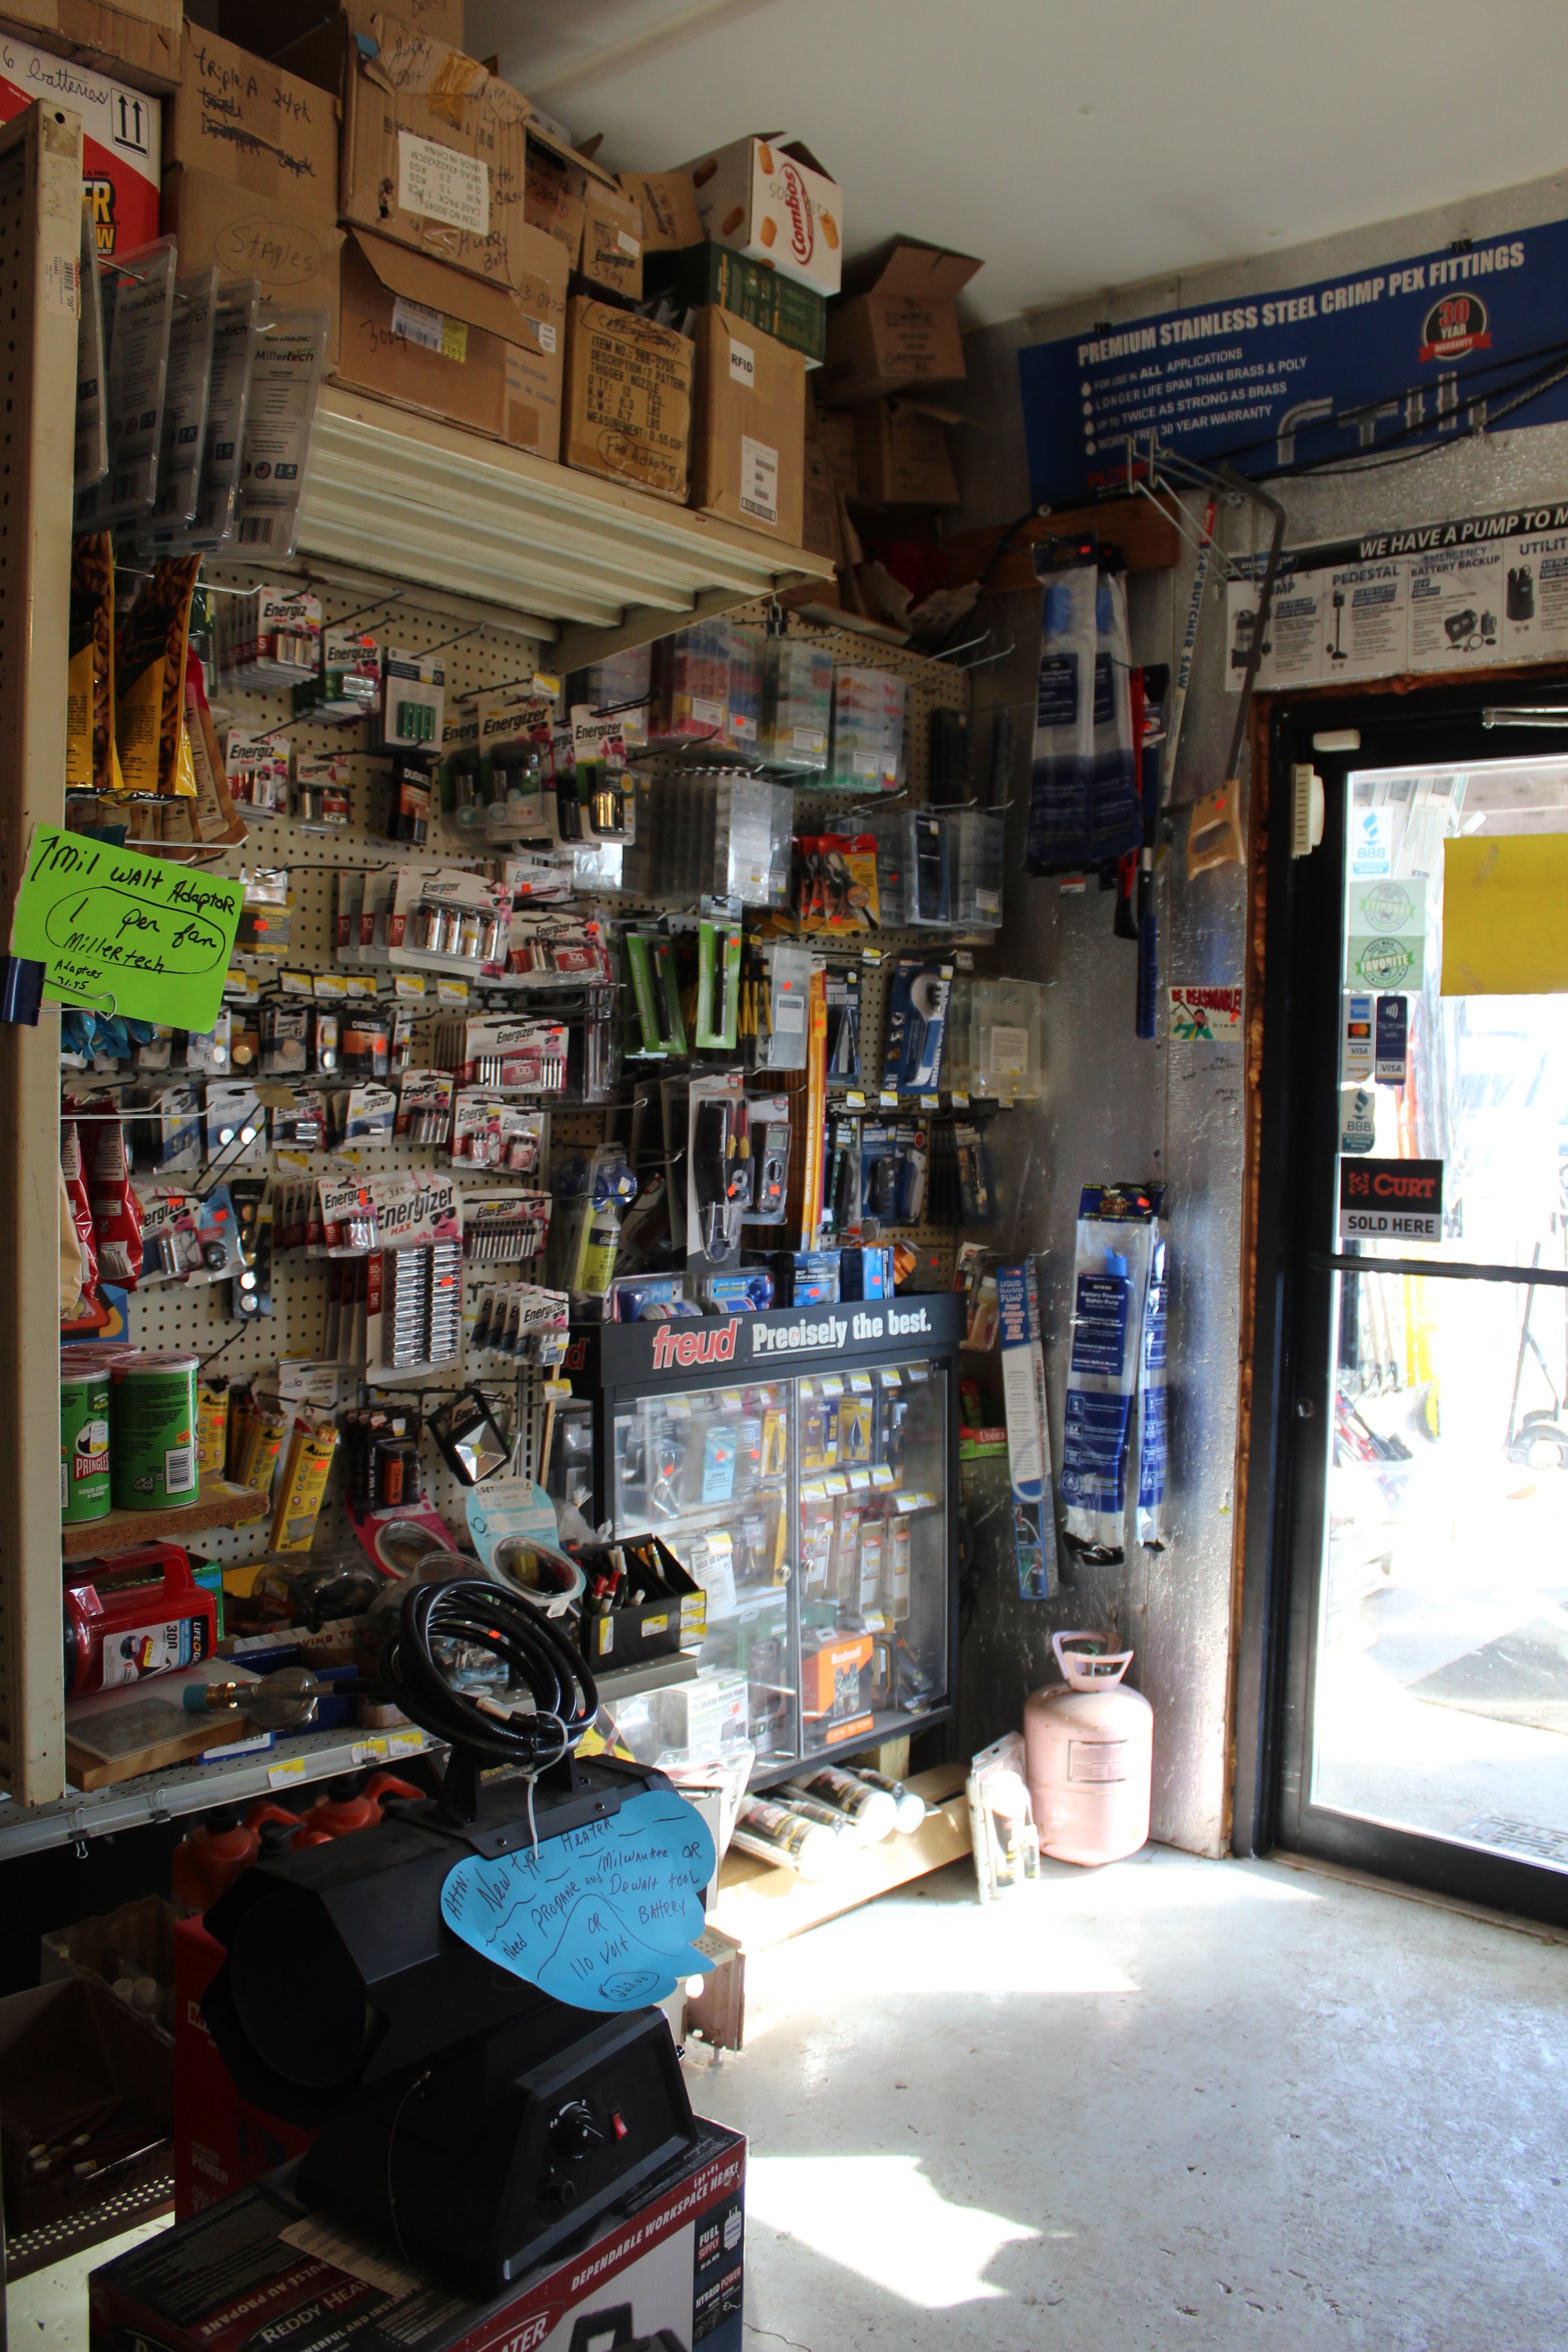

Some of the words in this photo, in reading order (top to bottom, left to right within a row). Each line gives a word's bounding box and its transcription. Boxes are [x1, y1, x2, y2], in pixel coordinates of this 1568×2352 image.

[246, 75, 258, 98] A
[790, 168, 810, 256] Combos
[1078, 327, 1157, 368] PREMIUM
[1160, 306, 1259, 346] STAINLESS
[1262, 294, 1317, 327] STEEL
[1321, 277, 1385, 314] CRIMP
[1389, 266, 1426, 297] PEX
[1429, 242, 1525, 287] FITTINGS
[1439, 298, 1470, 328] 30
[1440, 322, 1468, 339] YEAR
[591, 335, 613, 356] ITEM
[1434, 337, 1474, 353] WARRANTY
[254, 349, 315, 363] Millertech
[731, 351, 754, 374] RFID
[590, 361, 625, 383] TRIGGER
[630, 373, 660, 394] NOZZLE
[1094, 379, 1111, 391] FOR
[1111, 374, 1129, 388] USE
[1128, 371, 1138, 383] IN
[1140, 364, 1163, 380] ALL
[1167, 347, 1244, 374] APPLICATIONS
[655, 369, 687, 391] PATTERN
[1096, 389, 1140, 410] LONGER
[1143, 383, 1164, 400] LIFE
[1165, 378, 1193, 395] SPAN
[1195, 371, 1224, 389] THAN
[1226, 363, 1264, 382] BRASS
[1267, 363, 1276, 374] &
[1278, 356, 1308, 373] POLY
[622, 385, 632, 398] 12
[647, 404, 662, 419] LBS
[1097, 418, 1109, 432] UP
[1109, 415, 1120, 428] TO
[1121, 405, 1157, 425] TWICE
[1159, 401, 1175, 417] AS
[1177, 391, 1229, 412] STRONG
[1231, 388, 1246, 401] AS
[1248, 381, 1288, 398] BRASS
[645, 415, 662, 430] LBS
[1134, 426, 1158, 443] FREE
[1160, 423, 1174, 437] 30
[1175, 415, 1209, 433] YEAR
[1210, 405, 1273, 425] WARRANTY
[1359, 538, 1388, 560] WE
[1391, 528, 1443, 554] HAVE
[1443, 525, 1458, 545] A
[1461, 514, 1520, 543] PUMP
[1524, 510, 1551, 531] TO
[1424, 546, 1489, 564] EMERGENCY
[1332, 564, 1401, 586] PEDESTAL
[1411, 561, 1455, 577] BATTERY
[1458, 554, 1502, 570] BACKUP
[263, 602, 307, 619] Energiz
[1184, 578, 1204, 650] BUTCHER
[326, 645, 378, 662] Energizer
[1177, 655, 1192, 690] SAW
[482, 706, 548, 736] Energizer
[575, 721, 622, 740] Energizer
[229, 744, 275, 759] Energiz
[299, 763, 331, 776] Energizer
[514, 869, 553, 883] Energizer
[422, 881, 460, 893] Energizer
[392, 918, 405, 931] 10
[536, 922, 571, 937] Energizer
[1360, 953, 1411, 973] FAVORITE
[352, 1020, 381, 1030] DURACELL
[497, 1026, 537, 1044] Energizer
[1350, 1046, 1369, 1056] VISA
[1380, 1063, 1402, 1073] VISA
[457, 1104, 490, 1121] Energiz
[1347, 1121, 1372, 1131] BBB
[1374, 1172, 1436, 1199] CURT
[324, 1183, 372, 1210] Energizr
[376, 1184, 454, 1231] Energizer
[326, 1224, 336, 1236] 15
[390, 1221, 411, 1237] MAX
[1348, 1216, 1388, 1231] SOLD
[1392, 1218, 1435, 1234] HERE
[1000, 1279, 1022, 1288] LIQUID
[1000, 1293, 1024, 1303] PUMP
[1081, 1291, 1102, 1301] Battery
[523, 1299, 564, 1323] Energizer
[652, 1317, 739, 1370] freud
[752, 1315, 849, 1355] Precisely
[852, 1311, 884, 1341] the
[887, 1307, 933, 1337] best.
[979, 1431, 1007, 1443] UDDER
[78, 1488, 95, 1496] SOUR
[193, 1621, 202, 1642] LIFE
[831, 1645, 862, 1666] Bushnell
[681, 1841, 703, 1860] OR
[475, 1867, 512, 1914] New
[588, 1911, 609, 1936] OR
[191, 2153, 230, 2186] POWER
[570, 2228, 644, 2292] DEPENDABLE
[645, 2184, 709, 2238] WORKSPACE
[710, 2160, 740, 2191] HEAT!
[699, 2223, 721, 2245] FUEL
[697, 2234, 721, 2259] SUPPLY
[267, 2281, 289, 2299] AU
[695, 2282, 721, 2309] HYBRID
[720, 2264, 743, 2291] POWER
[199, 2293, 268, 2336] PROPANE
[260, 2303, 322, 2345] REDDY
[345, 2314, 370, 2333] AND
